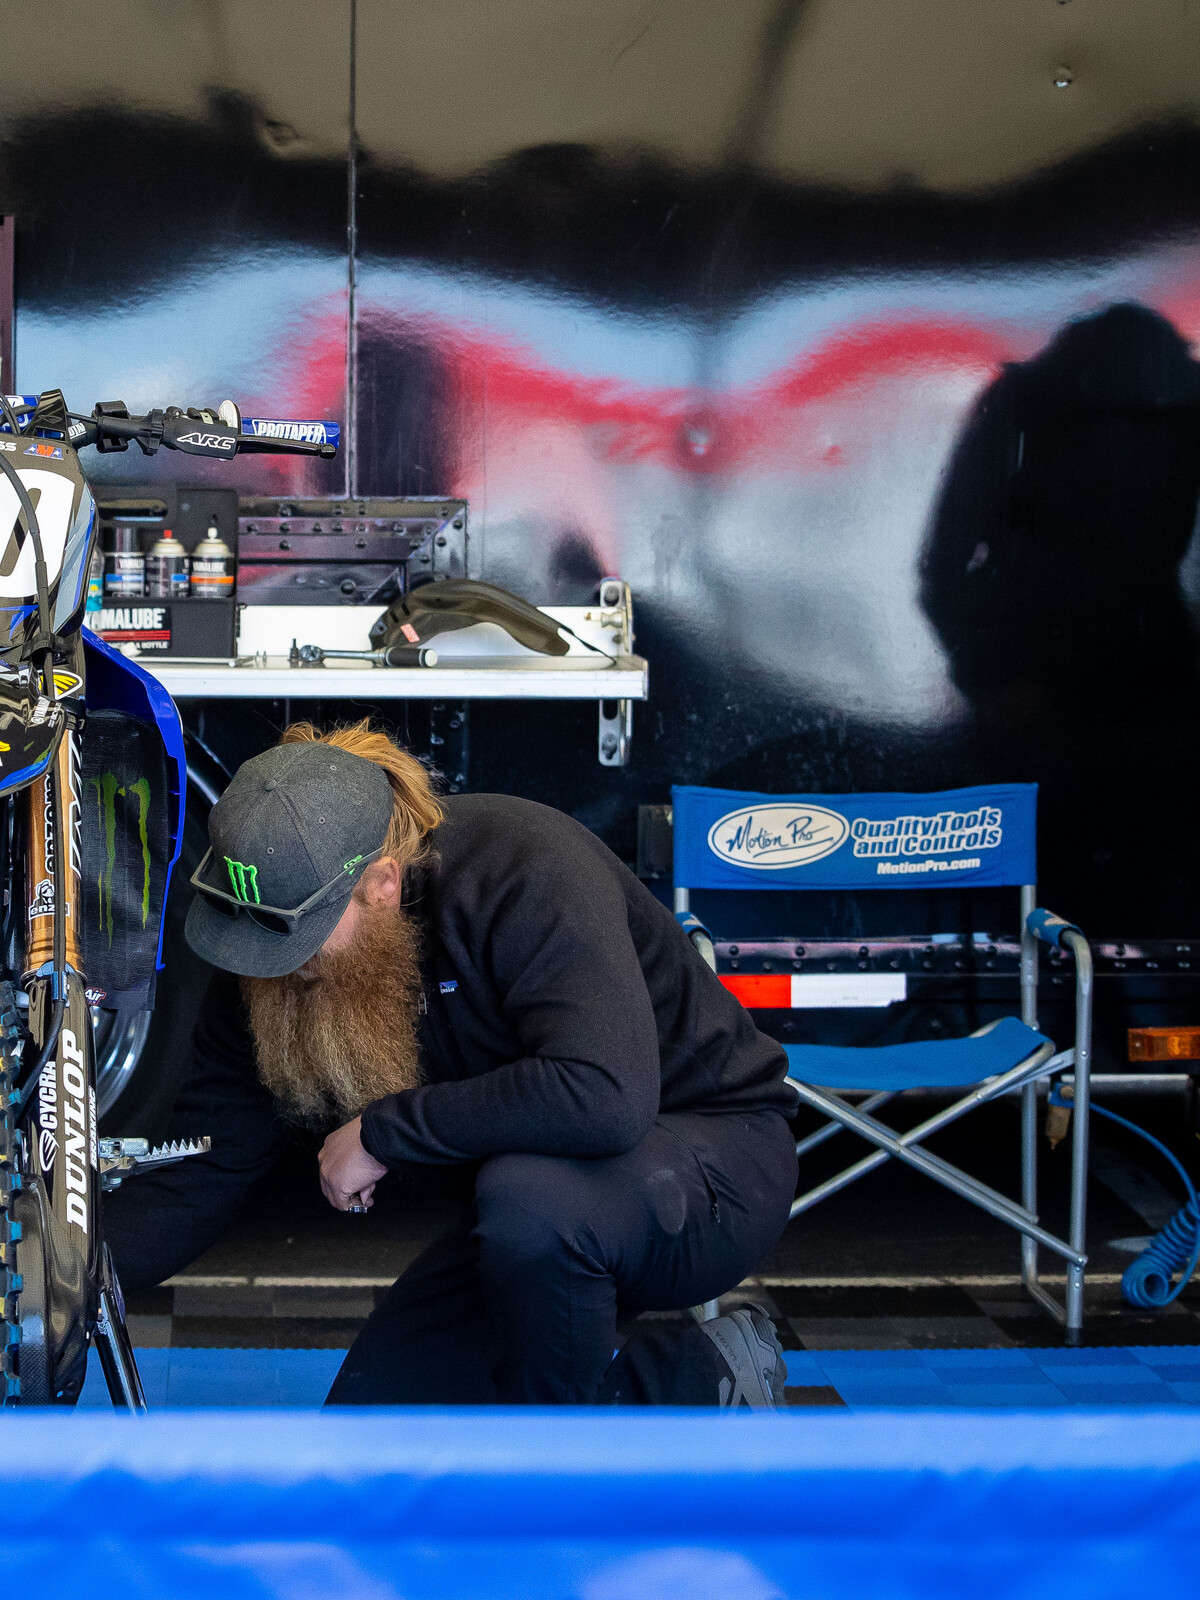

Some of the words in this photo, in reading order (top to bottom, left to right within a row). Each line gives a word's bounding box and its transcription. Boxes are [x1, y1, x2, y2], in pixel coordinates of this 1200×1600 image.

[177, 432, 236, 450] ARC
[257, 421, 325, 444] PROTAPER
[23, 444, 64, 460] AMA
[726, 815, 789, 854] Motion
[786, 815, 831, 844] Pro
[853, 818, 934, 840] Quality
[937, 807, 1000, 832] Tools
[855, 837, 899, 856] and
[903, 828, 1000, 853] Controls
[876, 858, 981, 875] MotionPro.com
[30, 904, 56, 916] enz
[85, 987, 104, 1002] Air
[39, 1060, 58, 1131] CYCRA
[63, 1028, 89, 1234] DUNLOP
